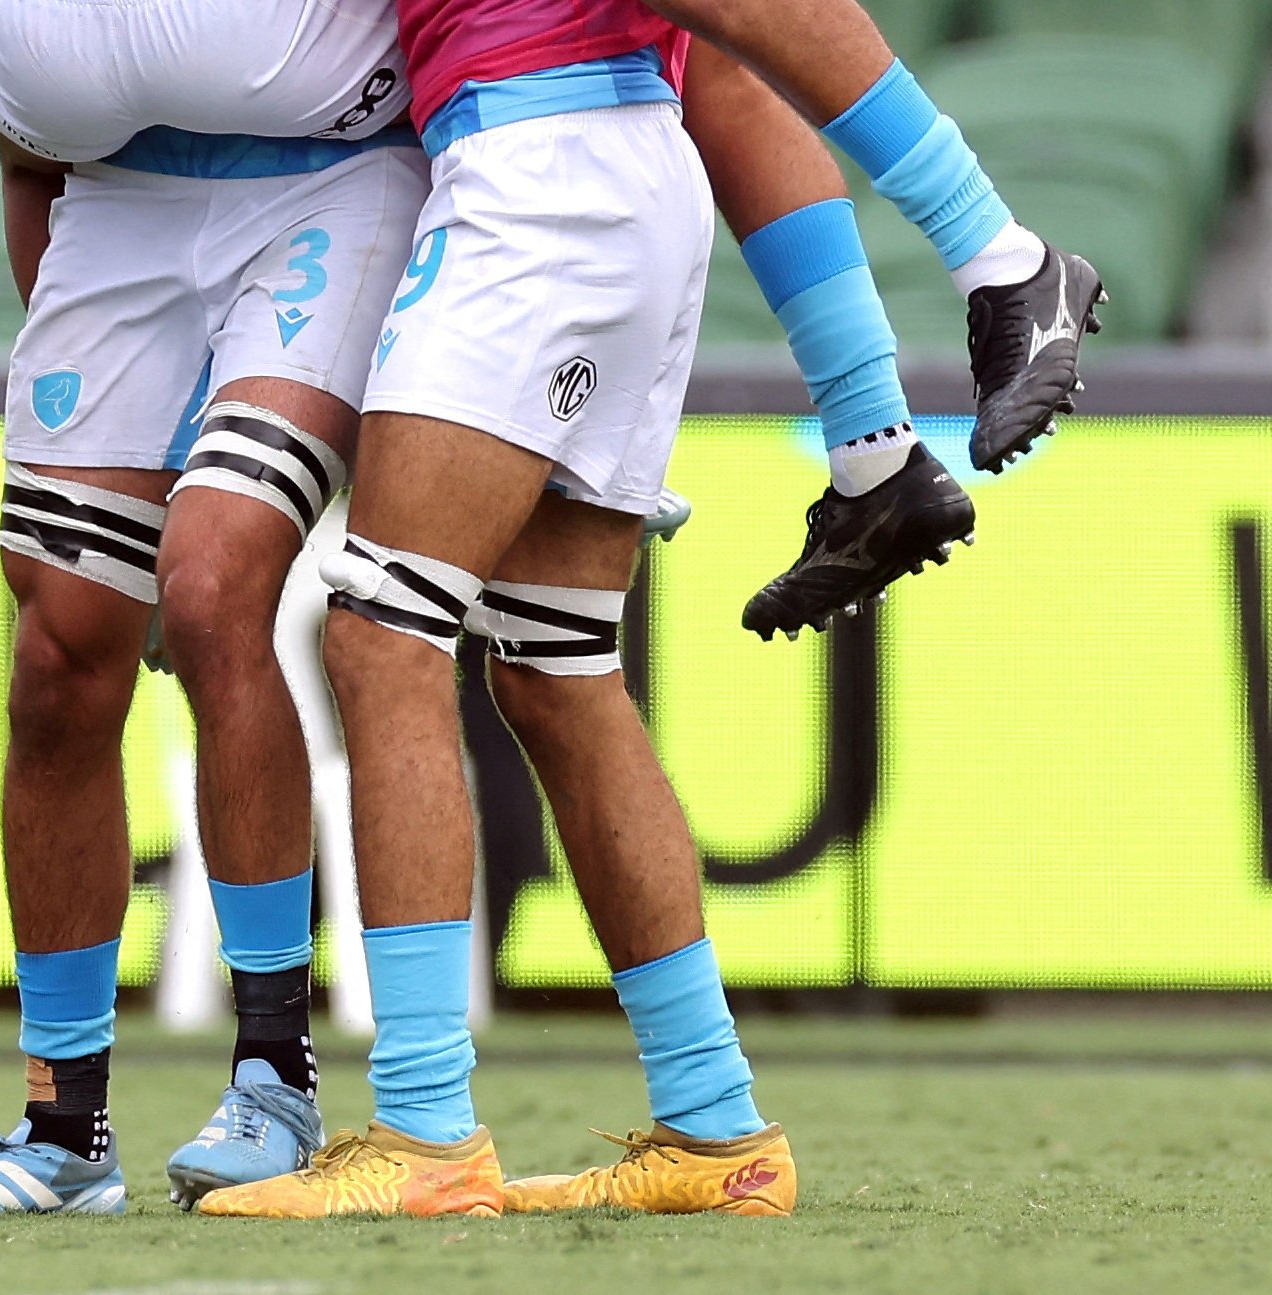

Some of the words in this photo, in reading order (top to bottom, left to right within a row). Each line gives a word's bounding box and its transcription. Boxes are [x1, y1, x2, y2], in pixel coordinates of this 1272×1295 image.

[271, 226, 331, 304] 3
[392, 226, 449, 314] 9
[551, 361, 592, 416] MG
